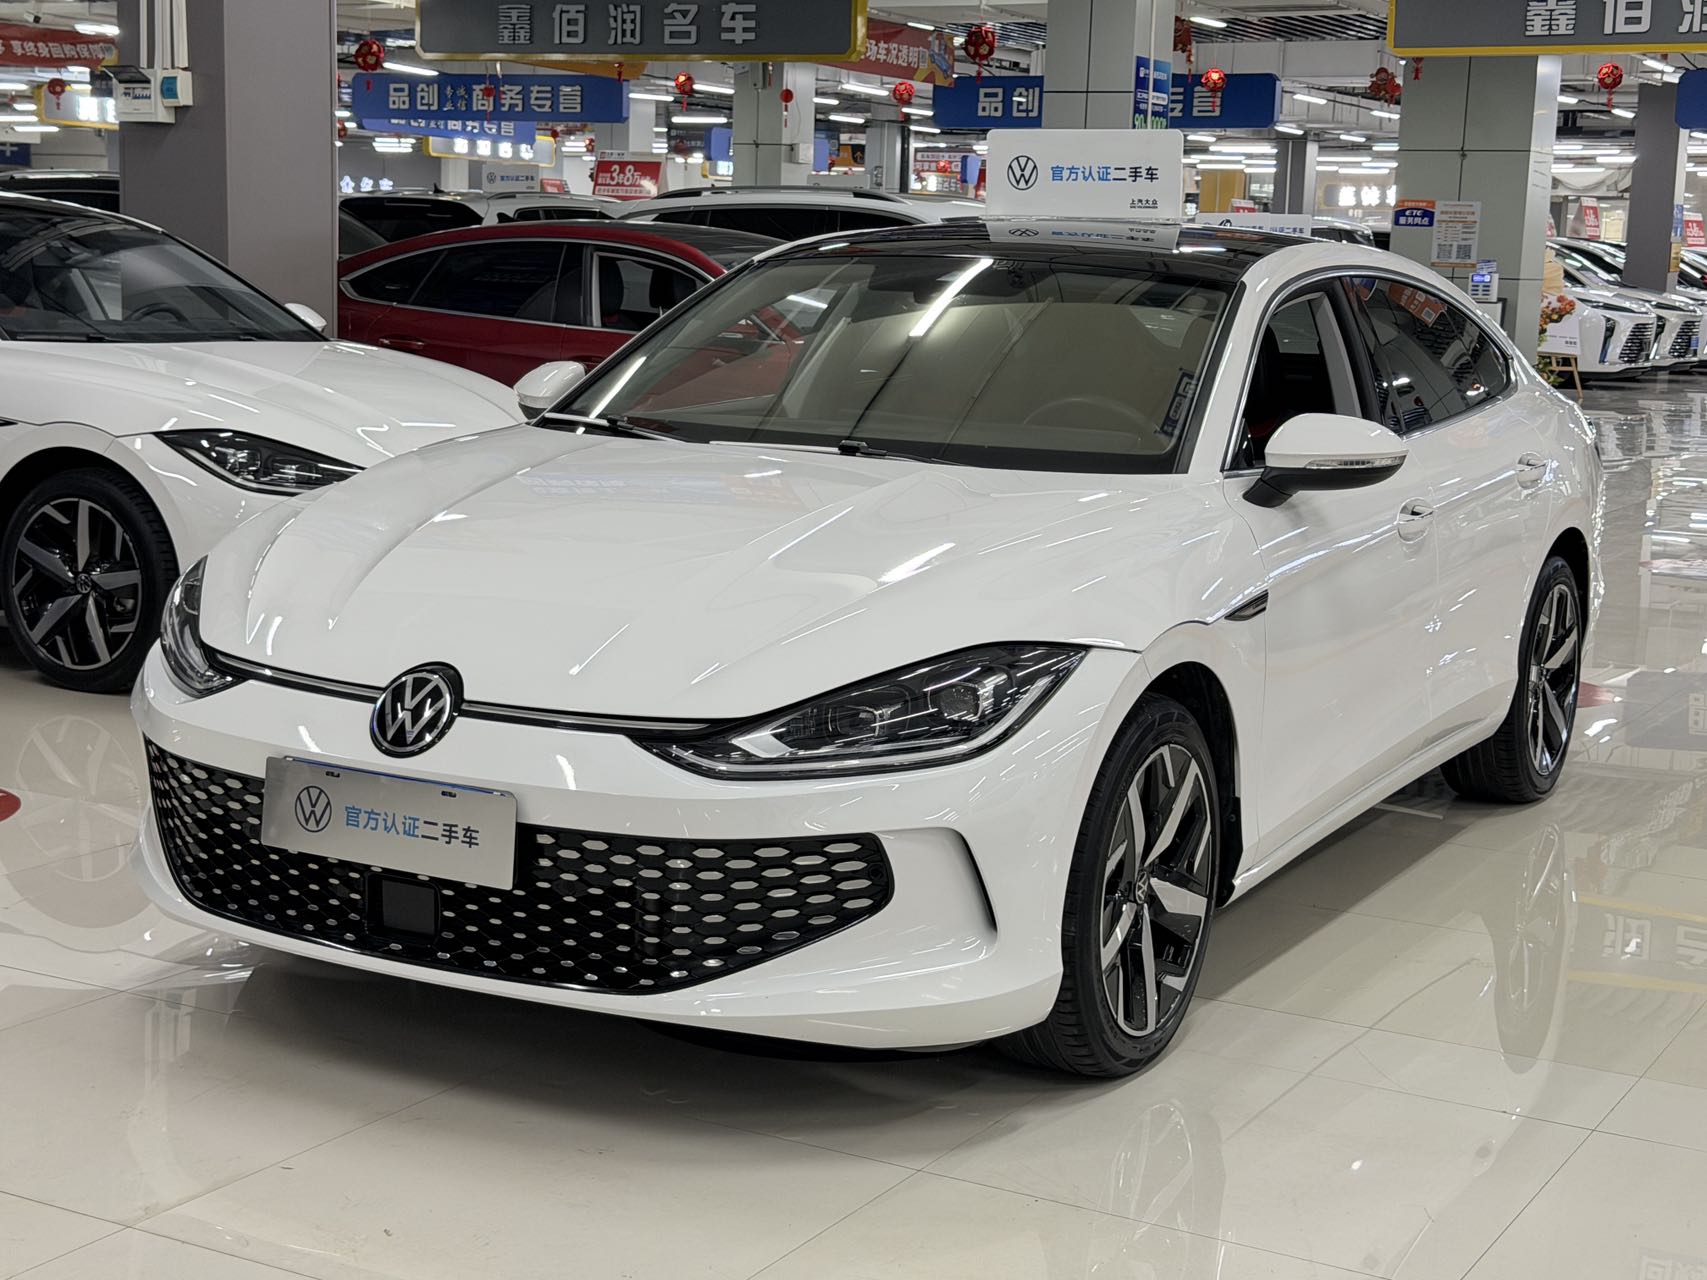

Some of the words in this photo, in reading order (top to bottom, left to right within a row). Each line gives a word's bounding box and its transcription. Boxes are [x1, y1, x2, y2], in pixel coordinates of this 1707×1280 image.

[497, 2, 758, 46] 鑫佰润名车
[861, 38, 918, 69] 场车况透明
[388, 83, 438, 111] 品创
[472, 84, 582, 113] 商务专营
[977, 87, 1040, 117] 品创
[1050, 165, 1159, 183] 官方认证二手车
[1129, 198, 1158, 206] 上汽大众
[344, 804, 480, 848] 官方认证二手车
